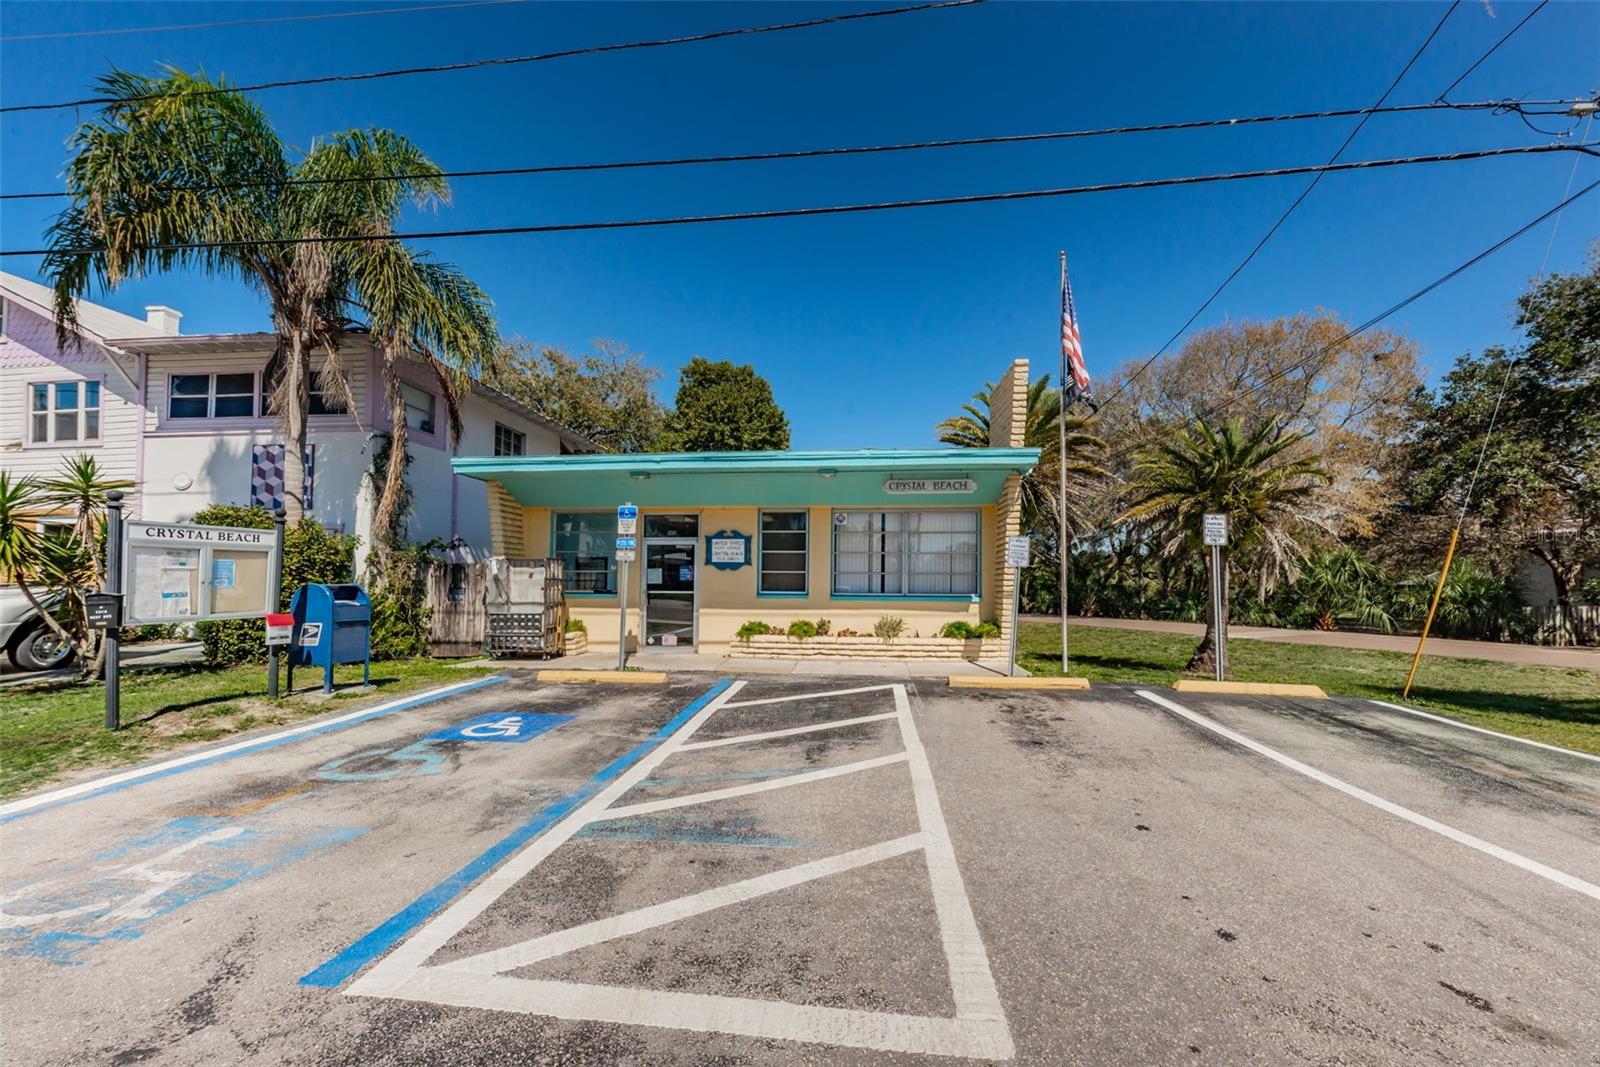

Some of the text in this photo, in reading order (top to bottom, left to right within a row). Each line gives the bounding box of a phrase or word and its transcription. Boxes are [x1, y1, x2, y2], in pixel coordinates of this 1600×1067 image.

[888, 481, 968, 490] CRYSTAL BEACH
[145, 527, 261, 543] CRYSTAL BEACH
